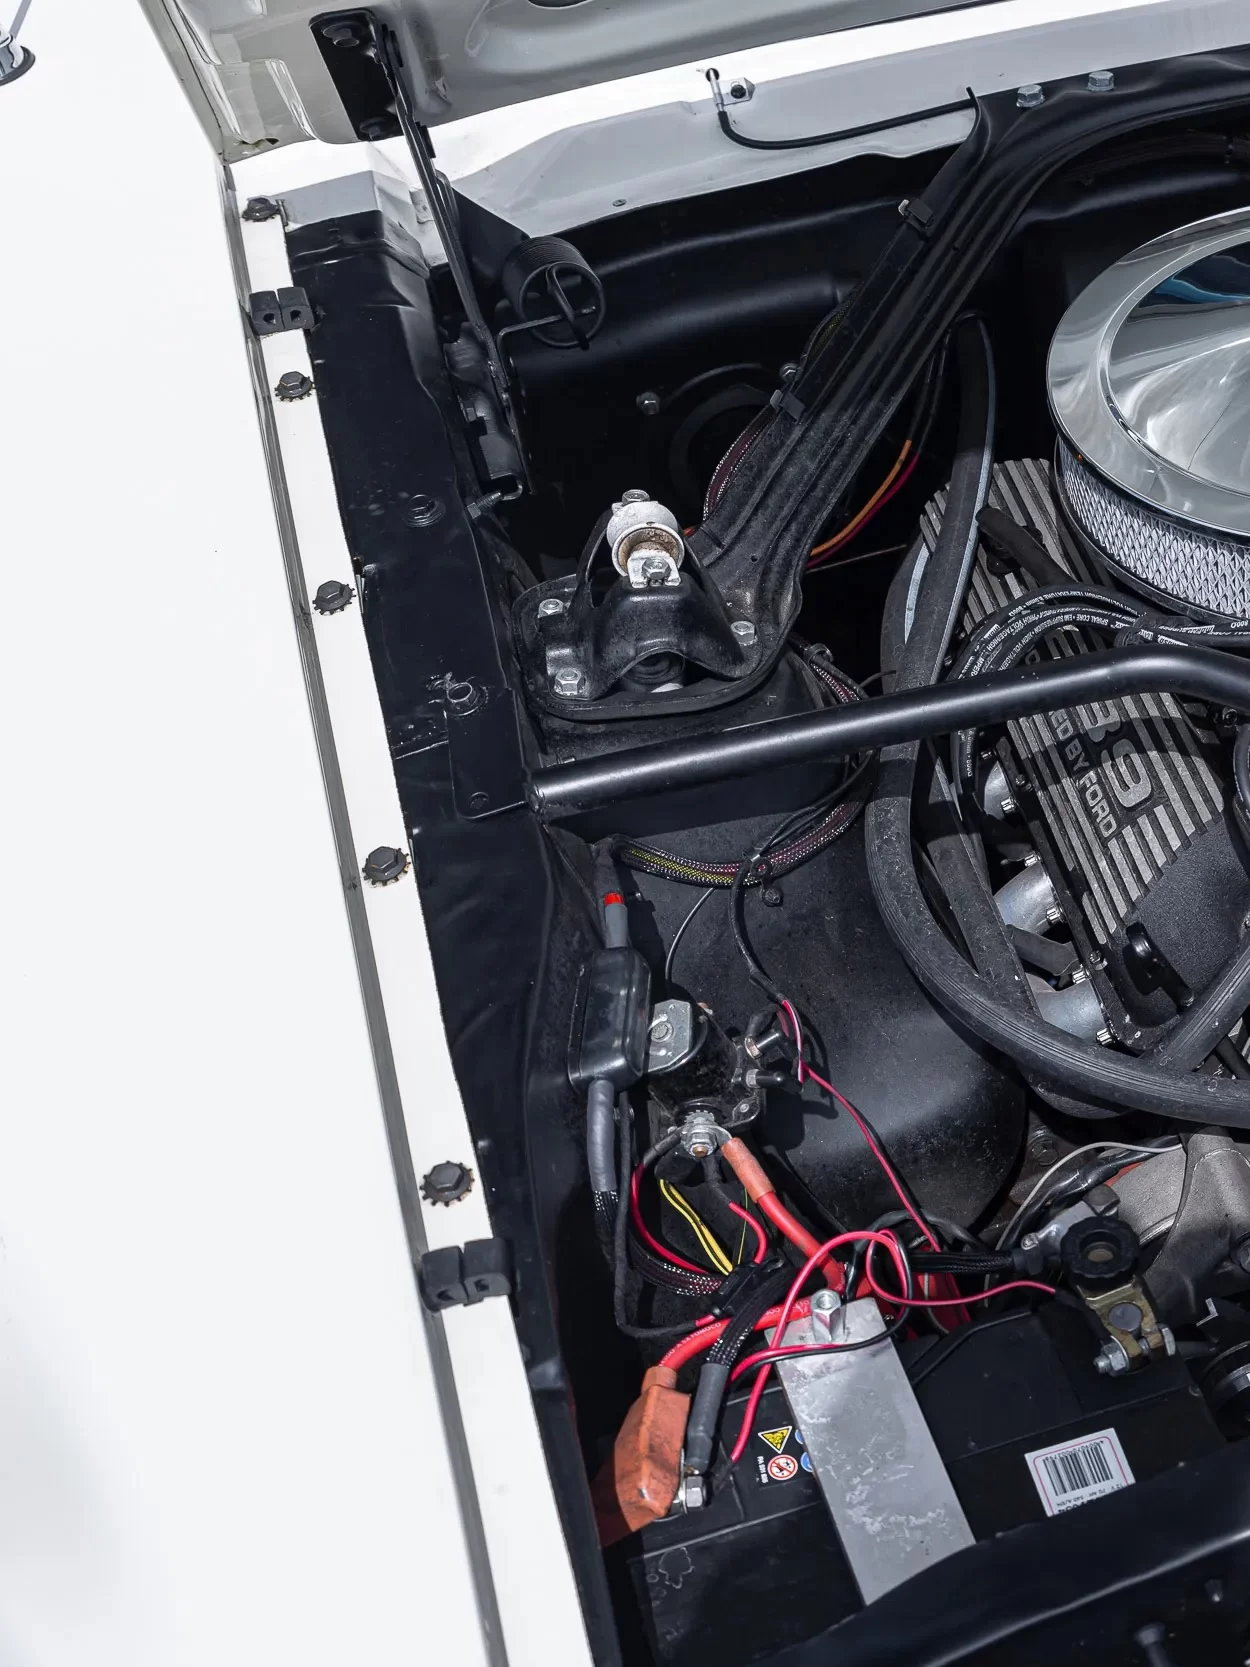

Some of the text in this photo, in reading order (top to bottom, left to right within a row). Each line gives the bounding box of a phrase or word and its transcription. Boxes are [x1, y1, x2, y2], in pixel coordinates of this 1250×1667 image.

[1076, 614, 1090, 622] CORE
[1091, 614, 1109, 625] SPIRAL
[1064, 739, 1117, 838] BY FORD
